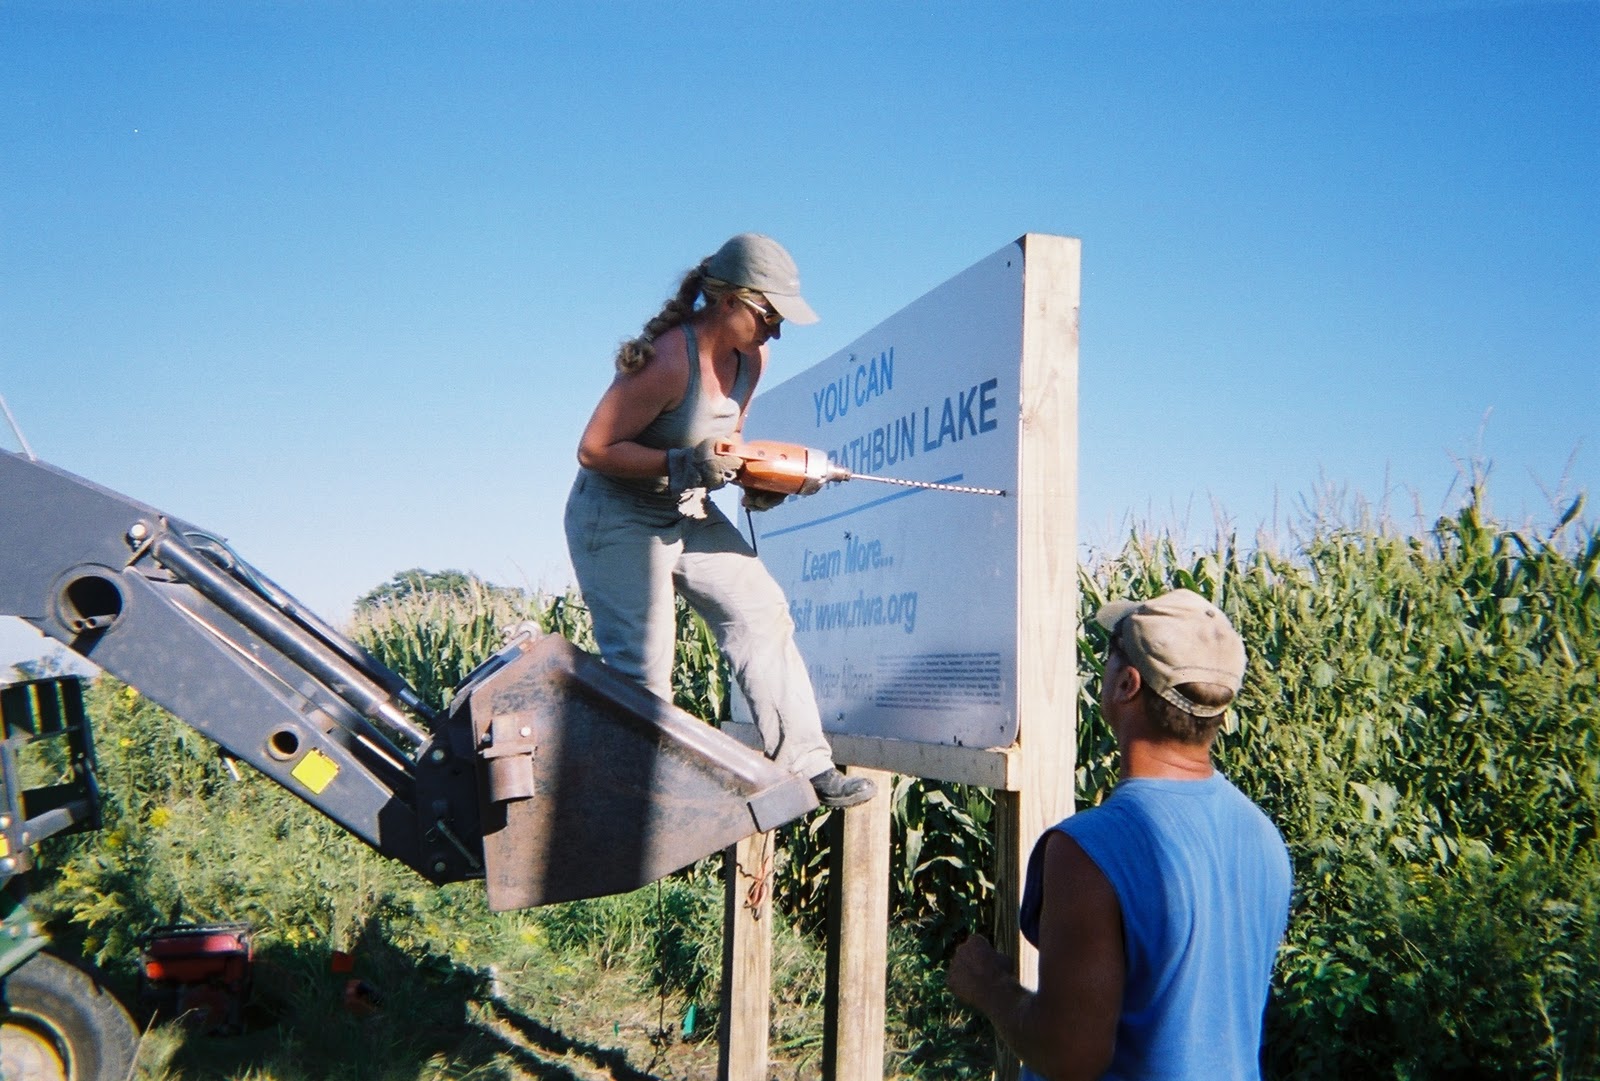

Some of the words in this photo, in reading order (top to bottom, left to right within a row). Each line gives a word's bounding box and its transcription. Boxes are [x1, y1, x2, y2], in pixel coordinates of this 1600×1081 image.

[813, 374, 850, 428] YOU
[854, 346, 894, 408] CAN
[923, 376, 998, 453] LAKE
[802, 549, 841, 582] Learn
